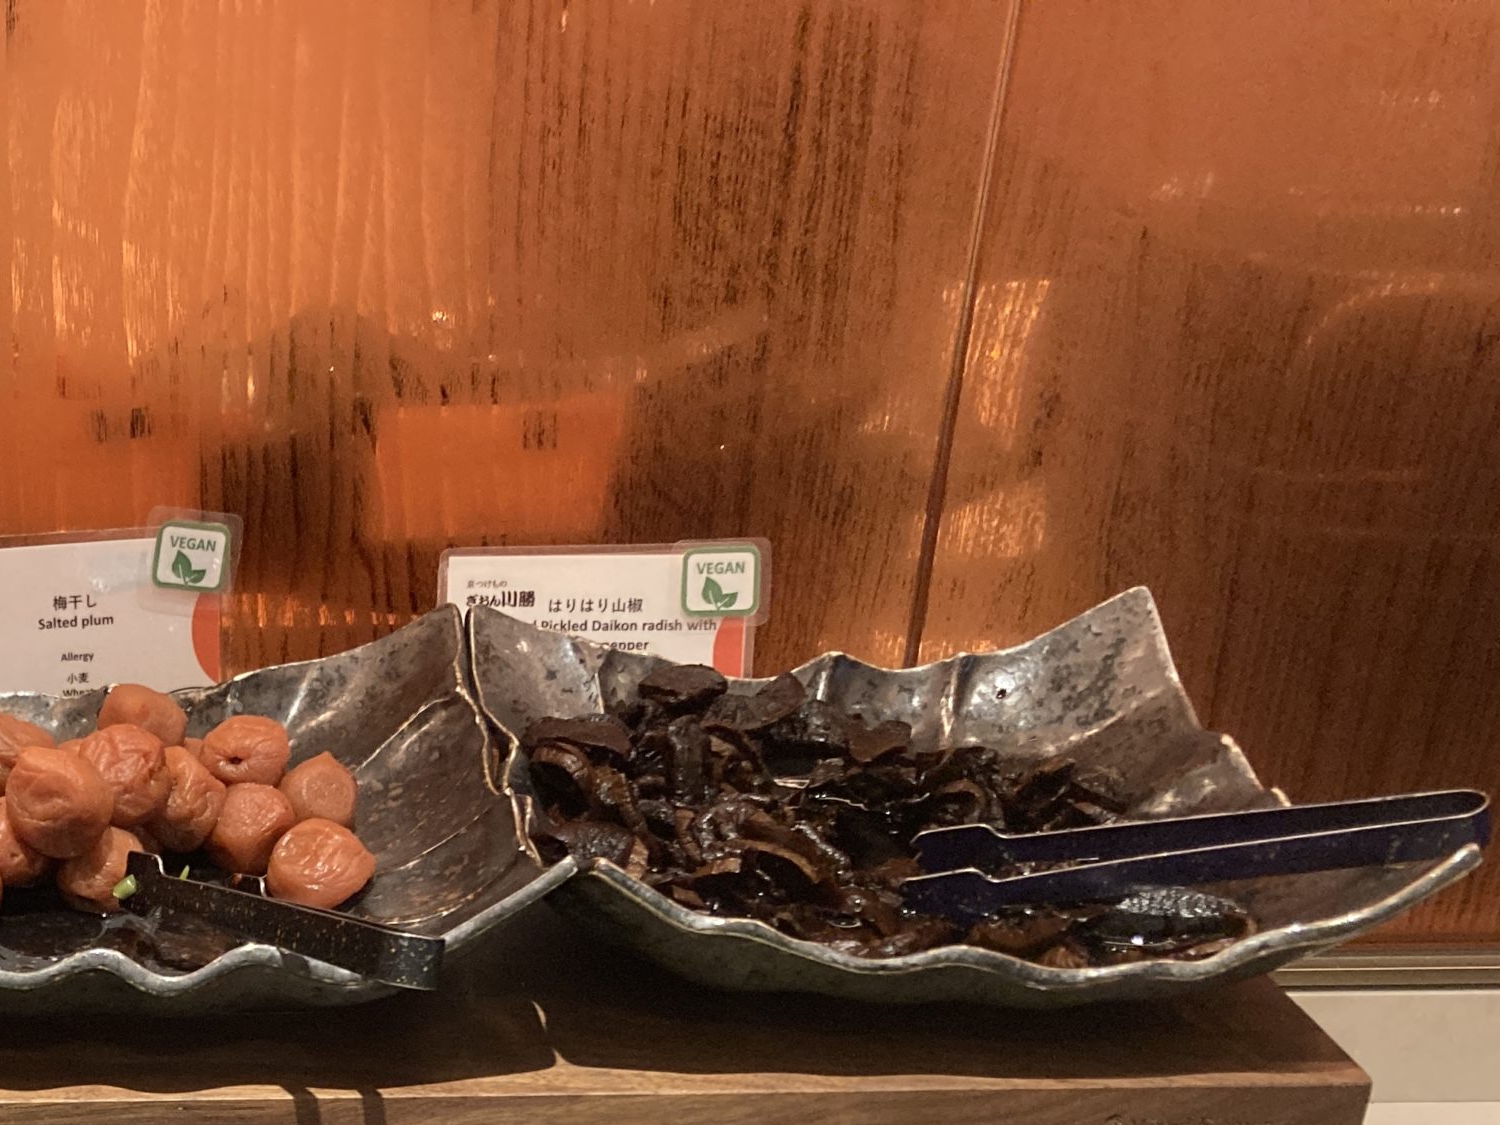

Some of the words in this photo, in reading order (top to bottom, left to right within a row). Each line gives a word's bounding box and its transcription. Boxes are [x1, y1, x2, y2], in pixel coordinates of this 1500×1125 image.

[170, 535, 217, 552] VEGAN
[696, 561, 746, 575] VEGAN
[52, 594, 97, 611] 梅干し
[548, 597, 644, 614] はりはり山椒
[38, 615, 78, 631] Salted
[81, 614, 114, 630] plum
[591, 619, 638, 632] Daikon
[642, 618, 683, 632] radish
[687, 619, 717, 632] with
[60, 651, 95, 663] Allergy
[67, 672, 89, 685] 小麦
